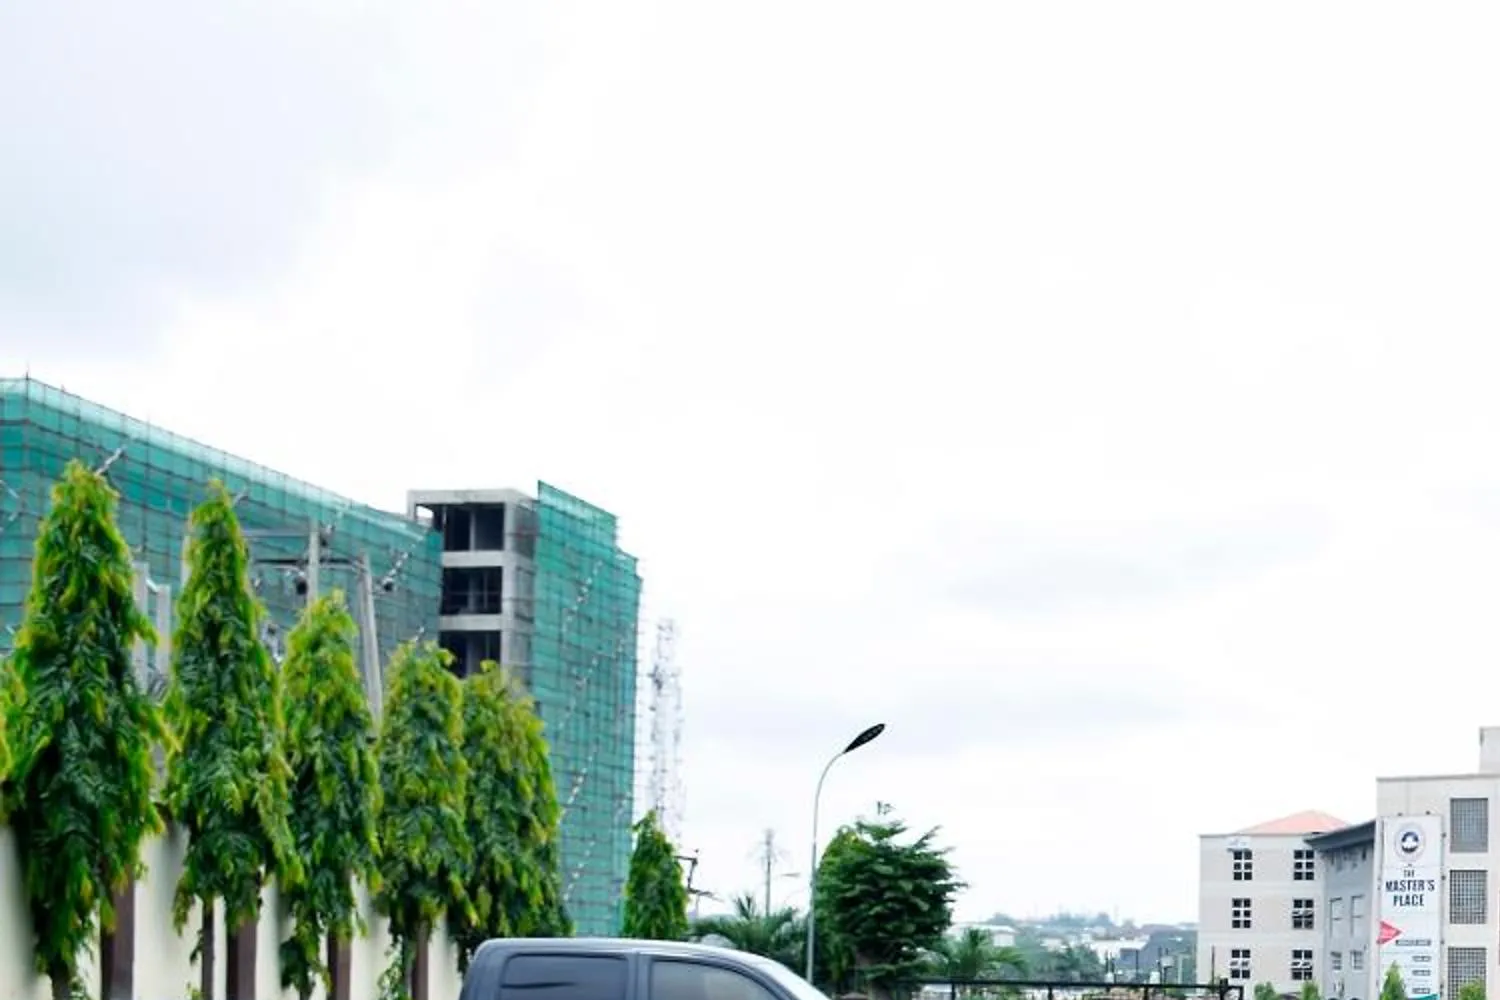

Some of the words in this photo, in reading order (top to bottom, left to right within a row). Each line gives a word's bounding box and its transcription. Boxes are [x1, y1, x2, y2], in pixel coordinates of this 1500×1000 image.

[1403, 869, 1415, 878] THE
[1385, 880, 1435, 892] MASTER'S
[1393, 894, 1424, 907] PLACE
